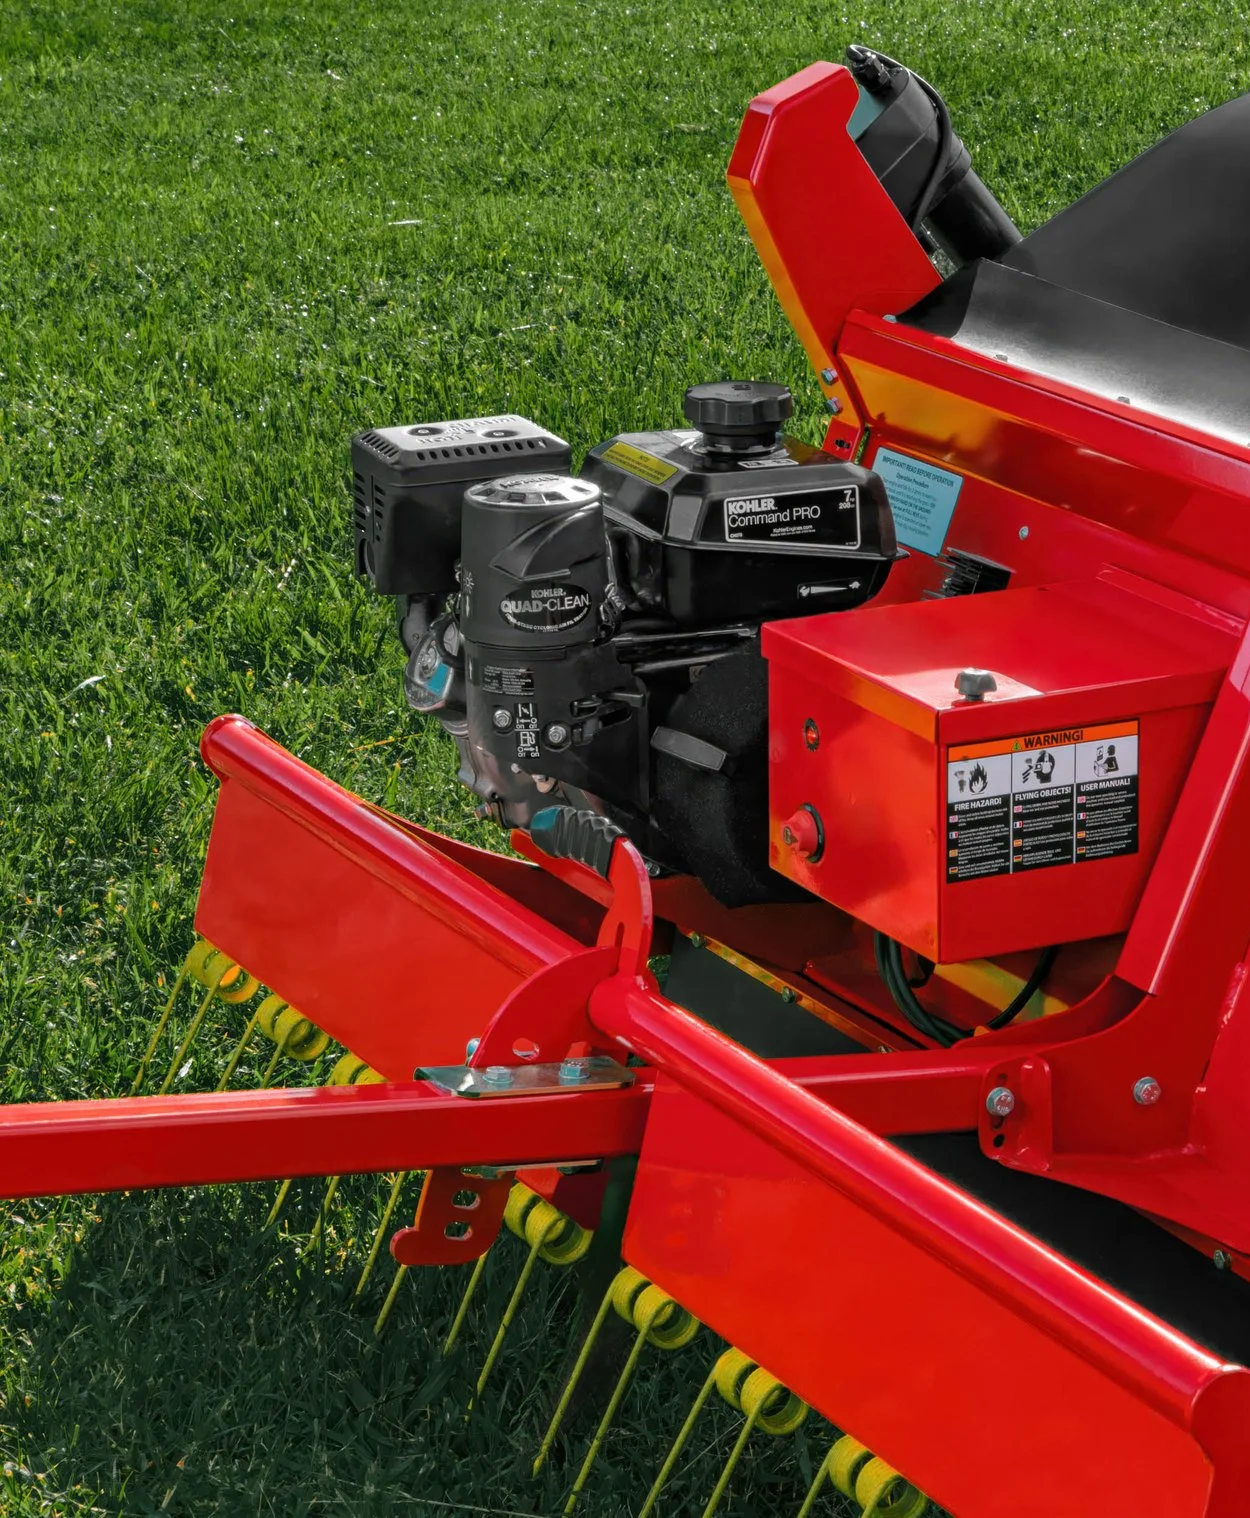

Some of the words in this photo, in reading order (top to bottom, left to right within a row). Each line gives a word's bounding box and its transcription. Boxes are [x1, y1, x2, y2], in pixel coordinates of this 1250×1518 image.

[728, 511, 790, 528] Command
[793, 505, 821, 521] PRO
[1024, 730, 1084, 749] WARNING!
[1080, 781, 1099, 792] USER
[1099, 778, 1131, 790] MANUAL!
[1015, 791, 1040, 802] FLYING
[1040, 786, 1072, 798] OBJECTS!
[954, 801, 970, 812] FIRE
[970, 797, 1002, 810] HAZARD!
